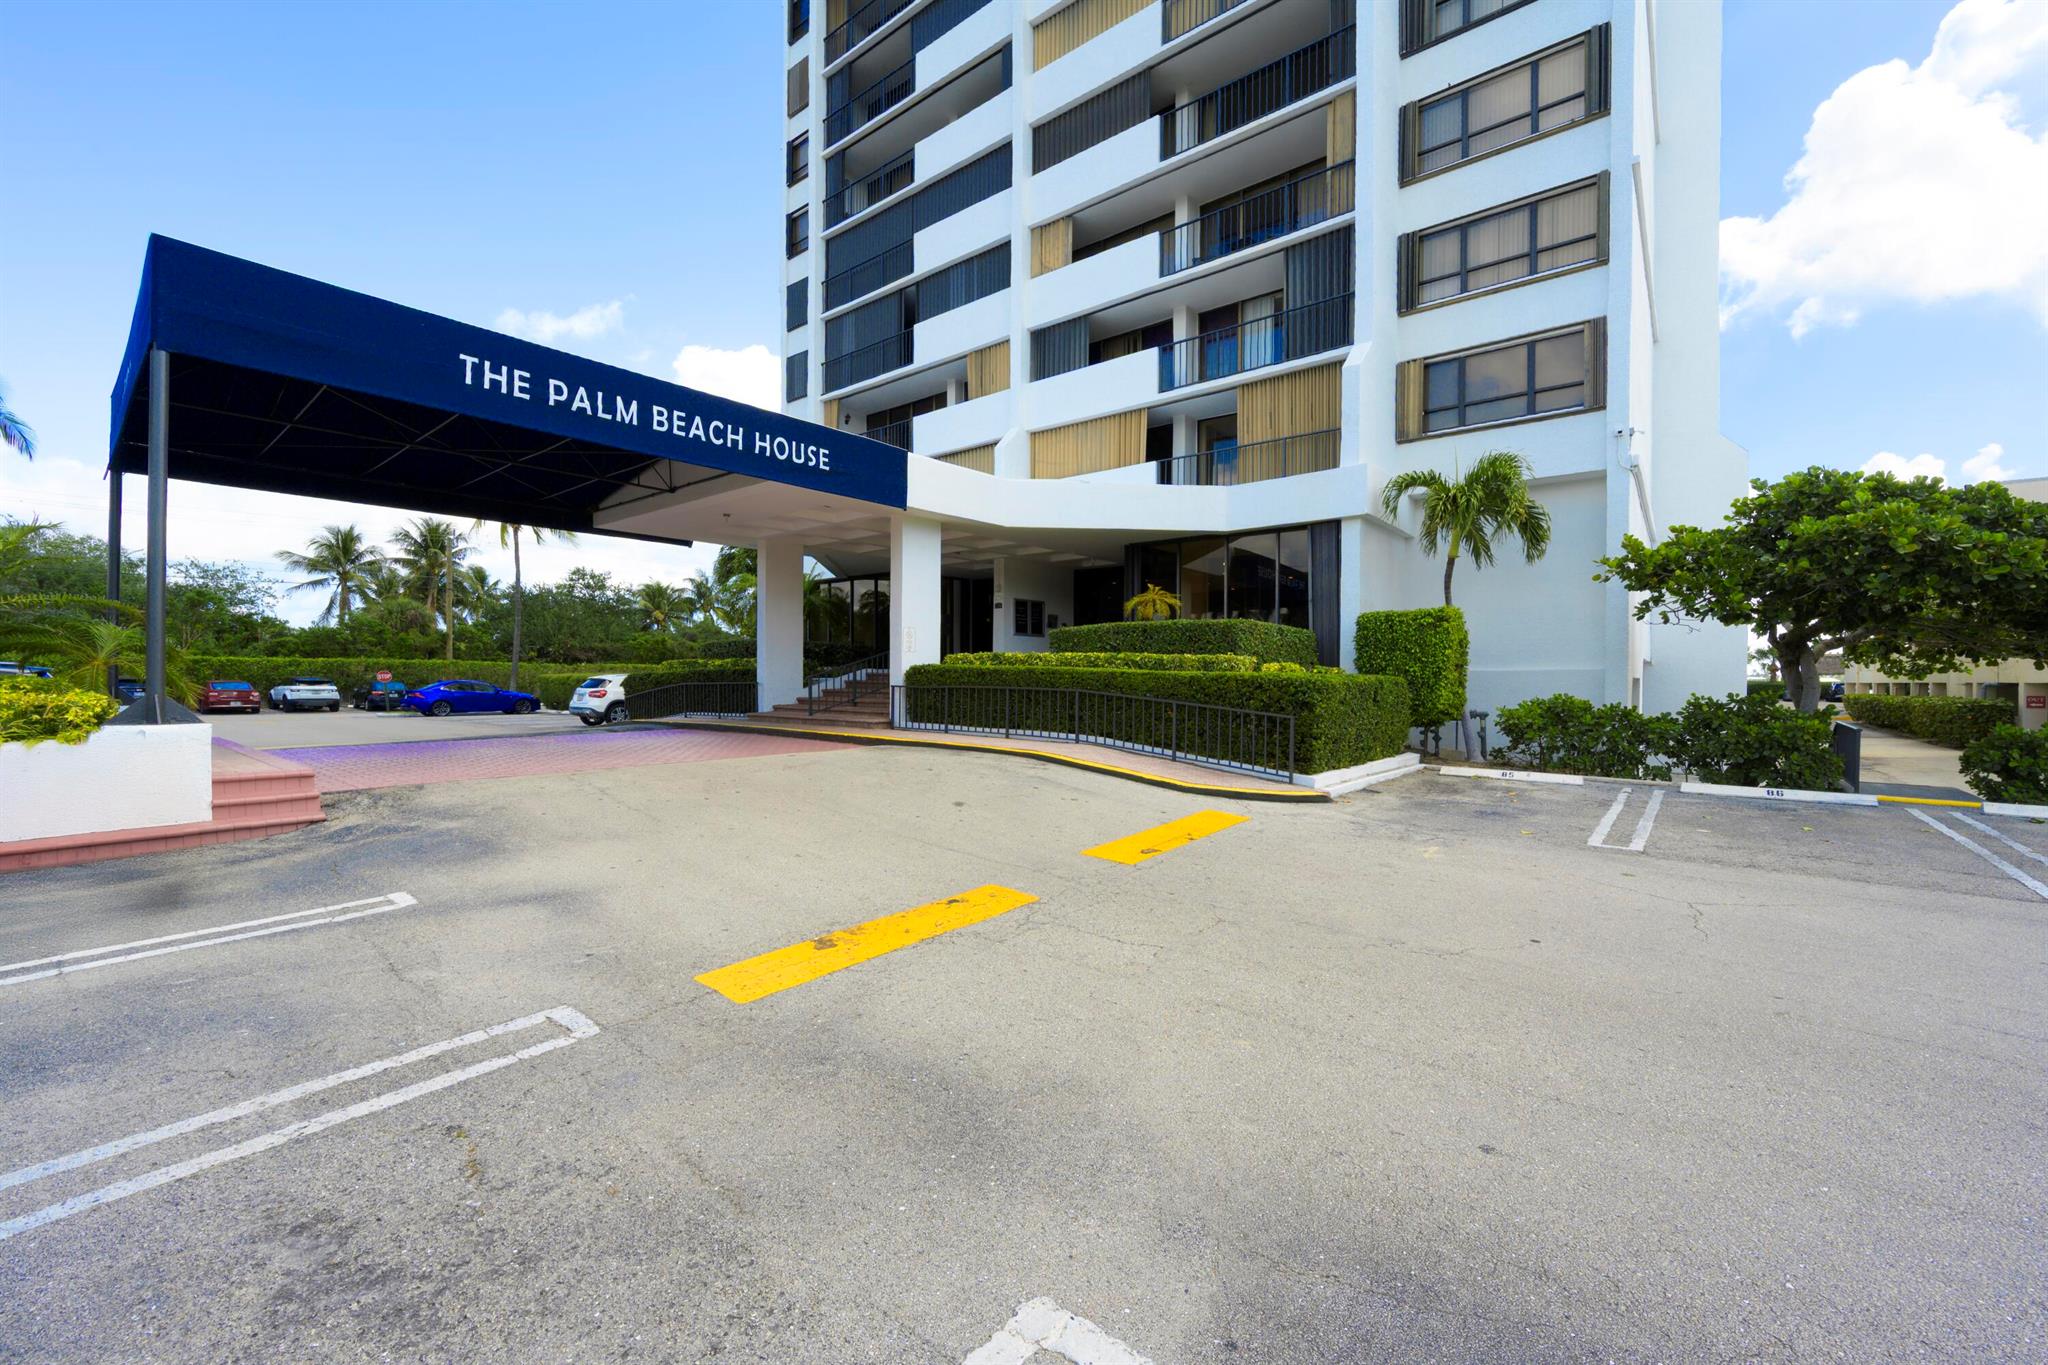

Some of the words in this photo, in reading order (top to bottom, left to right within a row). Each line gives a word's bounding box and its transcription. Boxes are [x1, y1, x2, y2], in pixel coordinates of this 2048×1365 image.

[459, 353, 531, 400] THE
[548, 378, 638, 426] PALM
[652, 404, 743, 450] BEACH
[754, 431, 830, 471] HOUSE
[1766, 789, 1784, 797] 86
